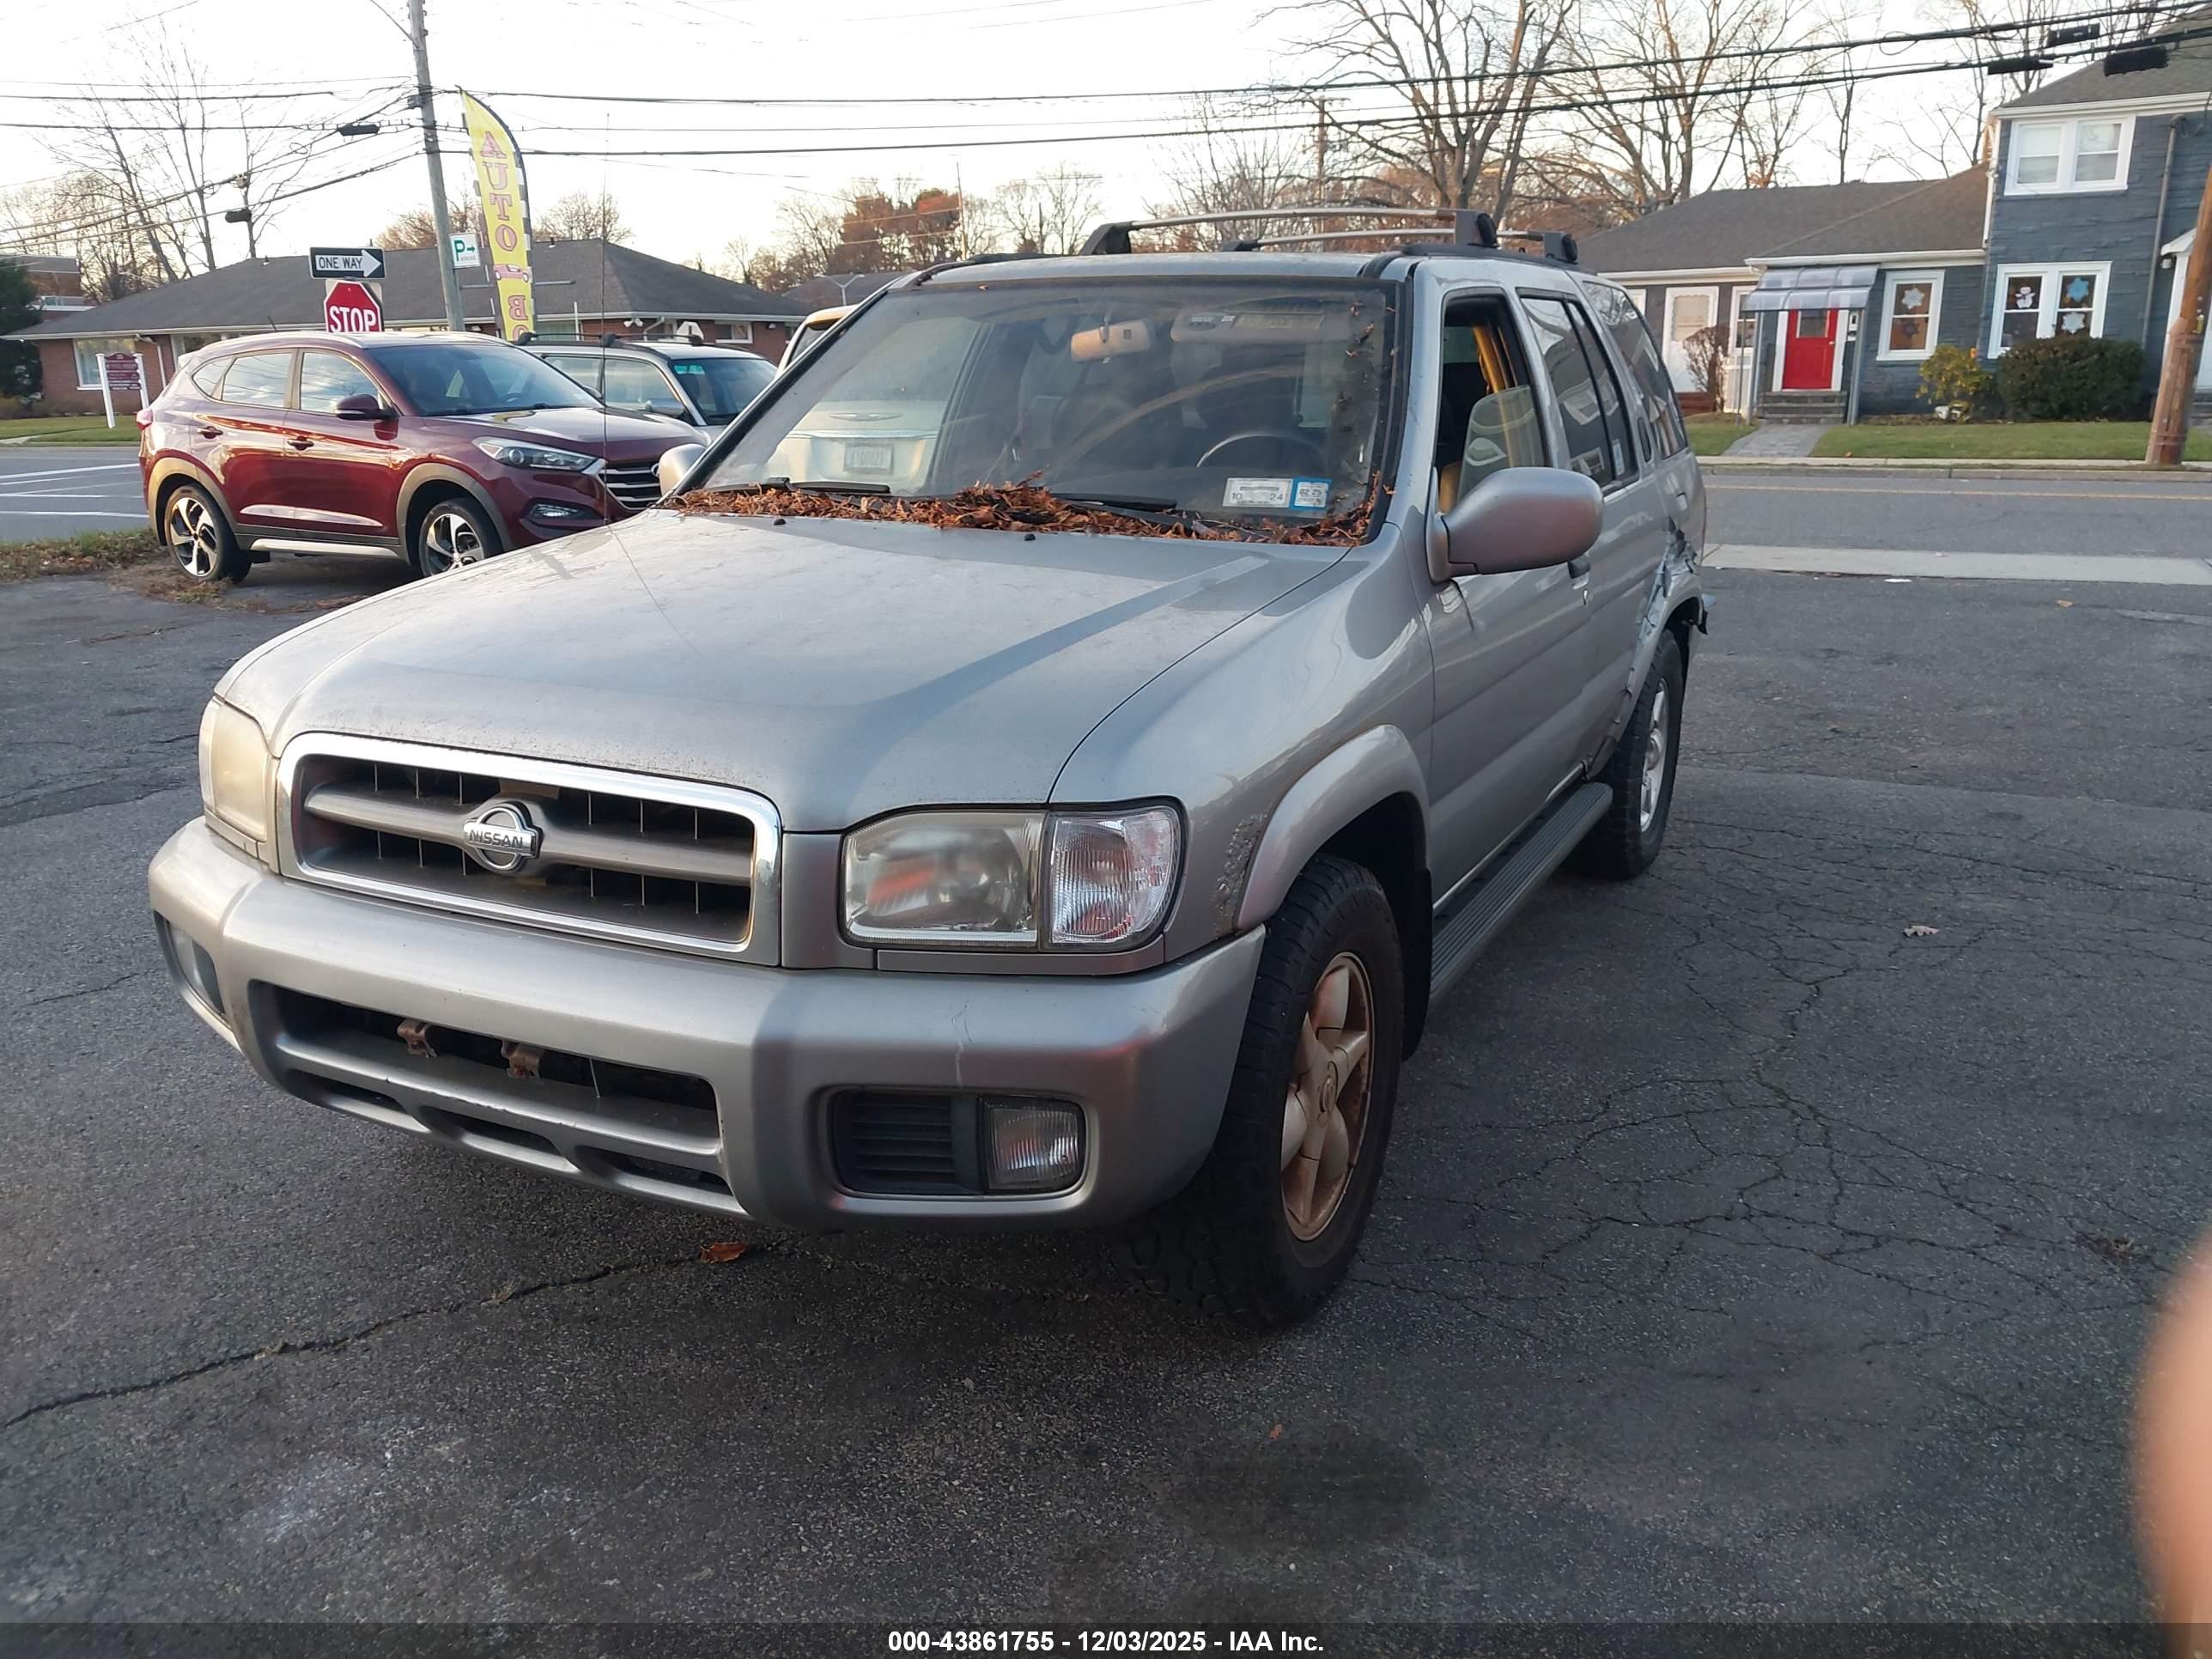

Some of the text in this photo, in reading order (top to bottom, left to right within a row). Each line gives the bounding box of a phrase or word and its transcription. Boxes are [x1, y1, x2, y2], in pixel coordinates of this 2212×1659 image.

[319, 257, 362, 269] ONE WAY
[329, 305, 377, 332] STOP
[1269, 493, 1284, 501] 24
[468, 829, 524, 849] NISSAN
